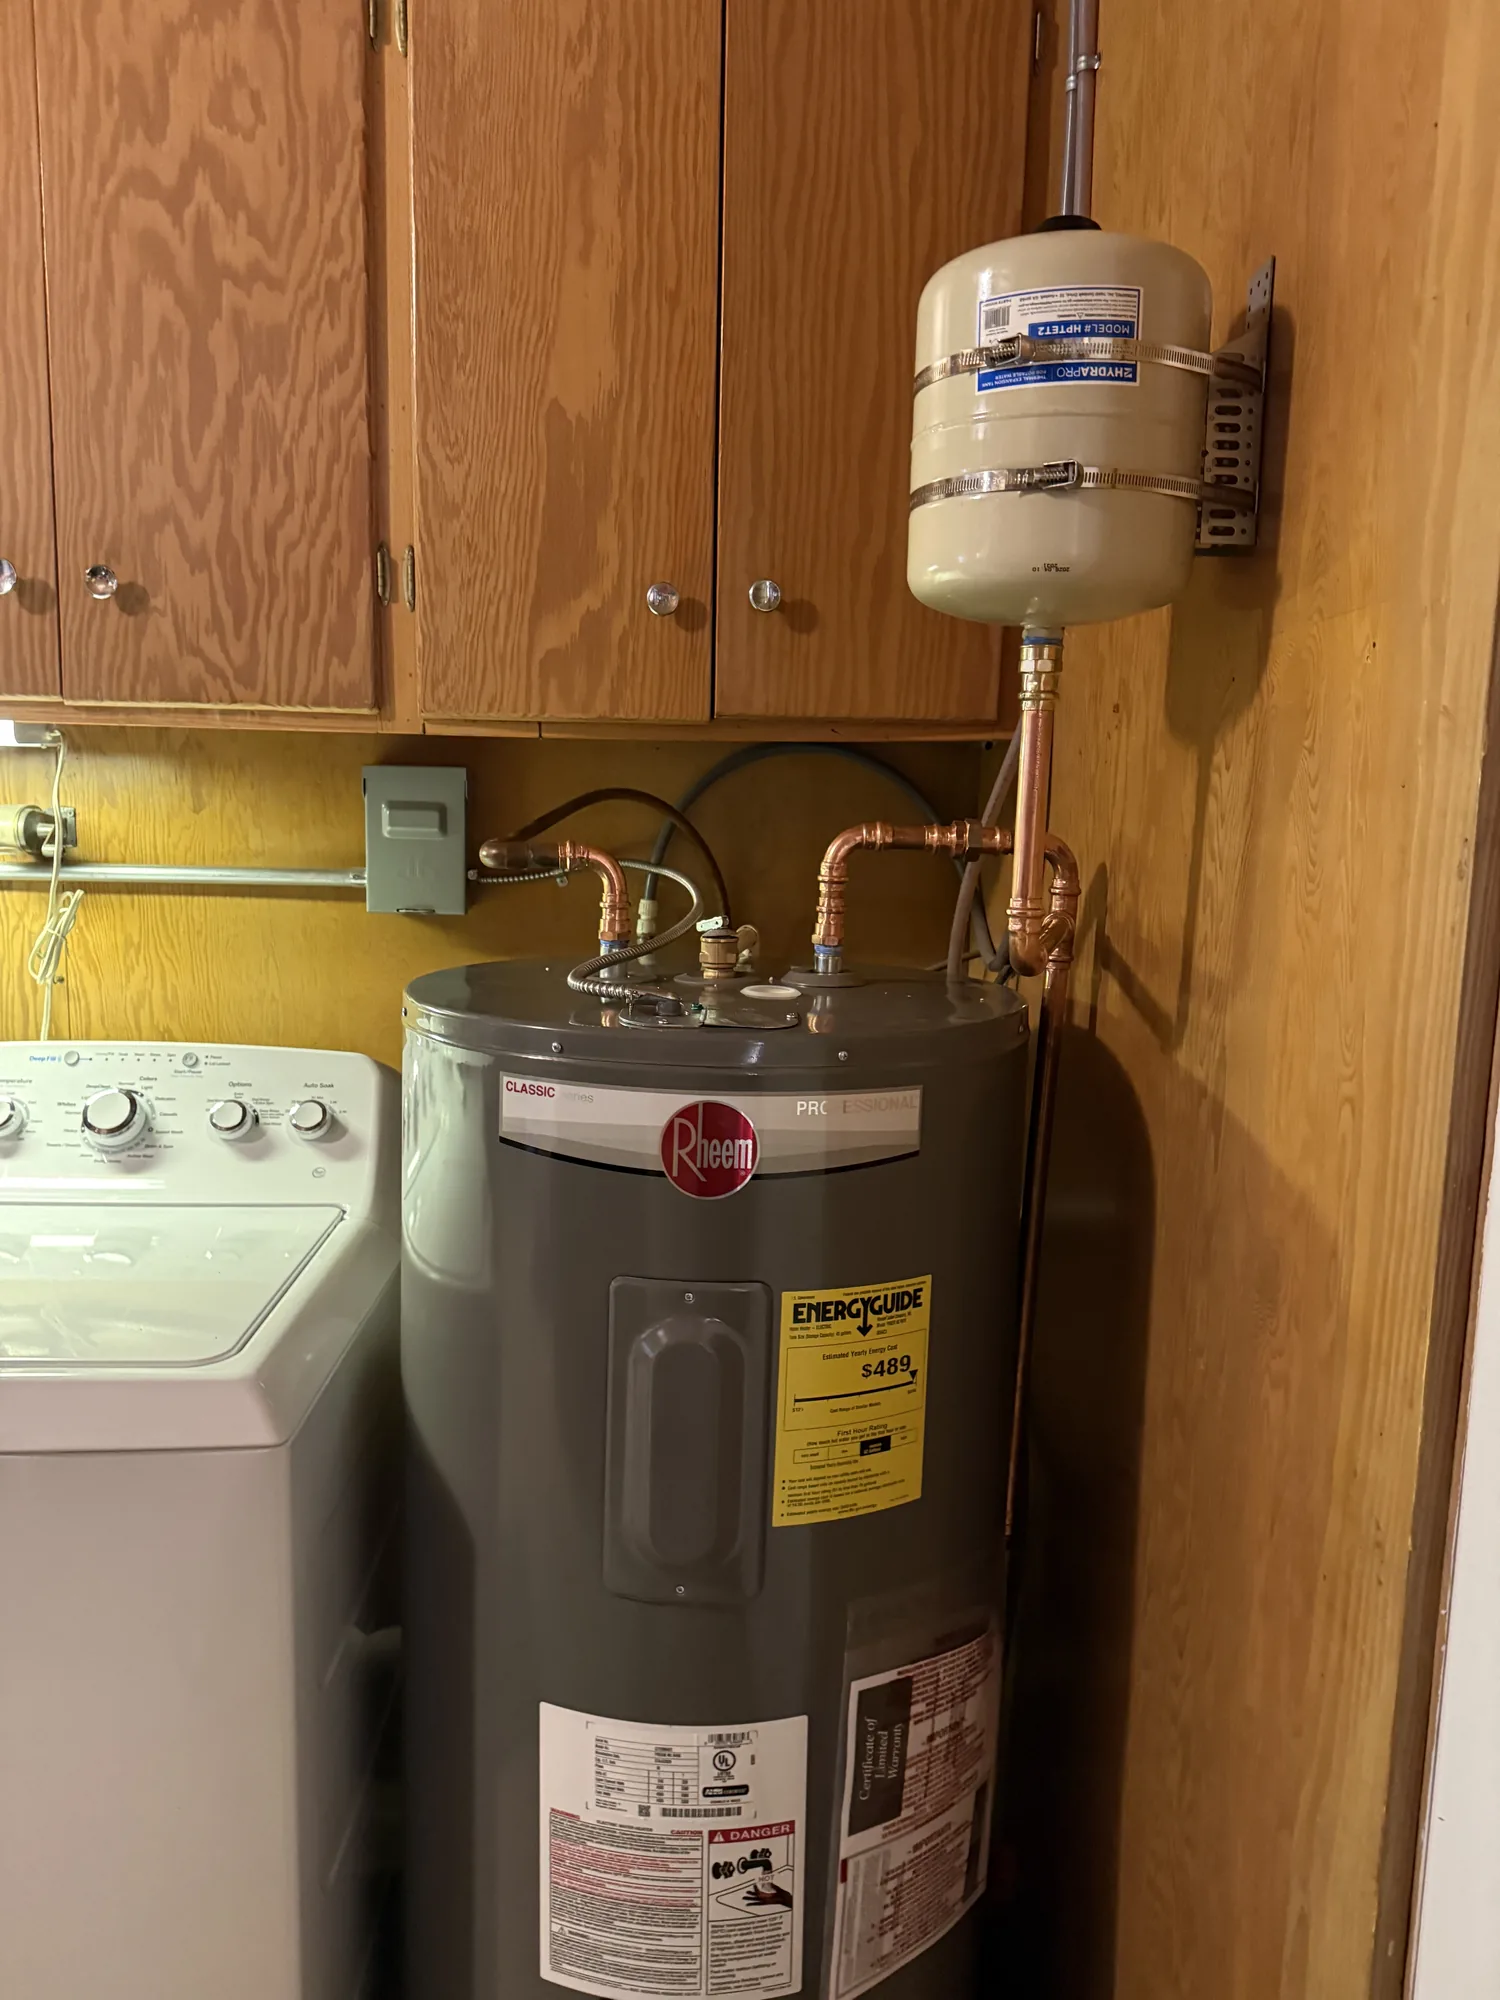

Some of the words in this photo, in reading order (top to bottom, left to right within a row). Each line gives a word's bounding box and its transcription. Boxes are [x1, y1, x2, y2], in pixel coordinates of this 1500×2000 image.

[1037, 324, 1081, 336] HPTET2
[1084, 323, 1130, 335] MODEL#
[1056, 366, 1123, 378] HYDRAPRO
[505, 1080, 555, 1098] CLASSIC
[796, 1095, 918, 1116] PROESSIONAL
[671, 1102, 753, 1182] Rheem
[793, 1287, 923, 1324] ENERGYGUIDE
[822, 1351, 849, 1361] Estimated
[851, 1349, 867, 1357] Yearly
[869, 1346, 886, 1355] Energy
[861, 1355, 911, 1379] $489
[869, 1424, 888, 1432] Rating
[864, 1716, 877, 1731] of
[874, 1731, 888, 1778] Limited
[887, 1723, 903, 1779] Warranty
[718, 1754, 730, 1767] UL
[858, 1735, 874, 1801] Certificate
[730, 1824, 790, 1840] DANGER
